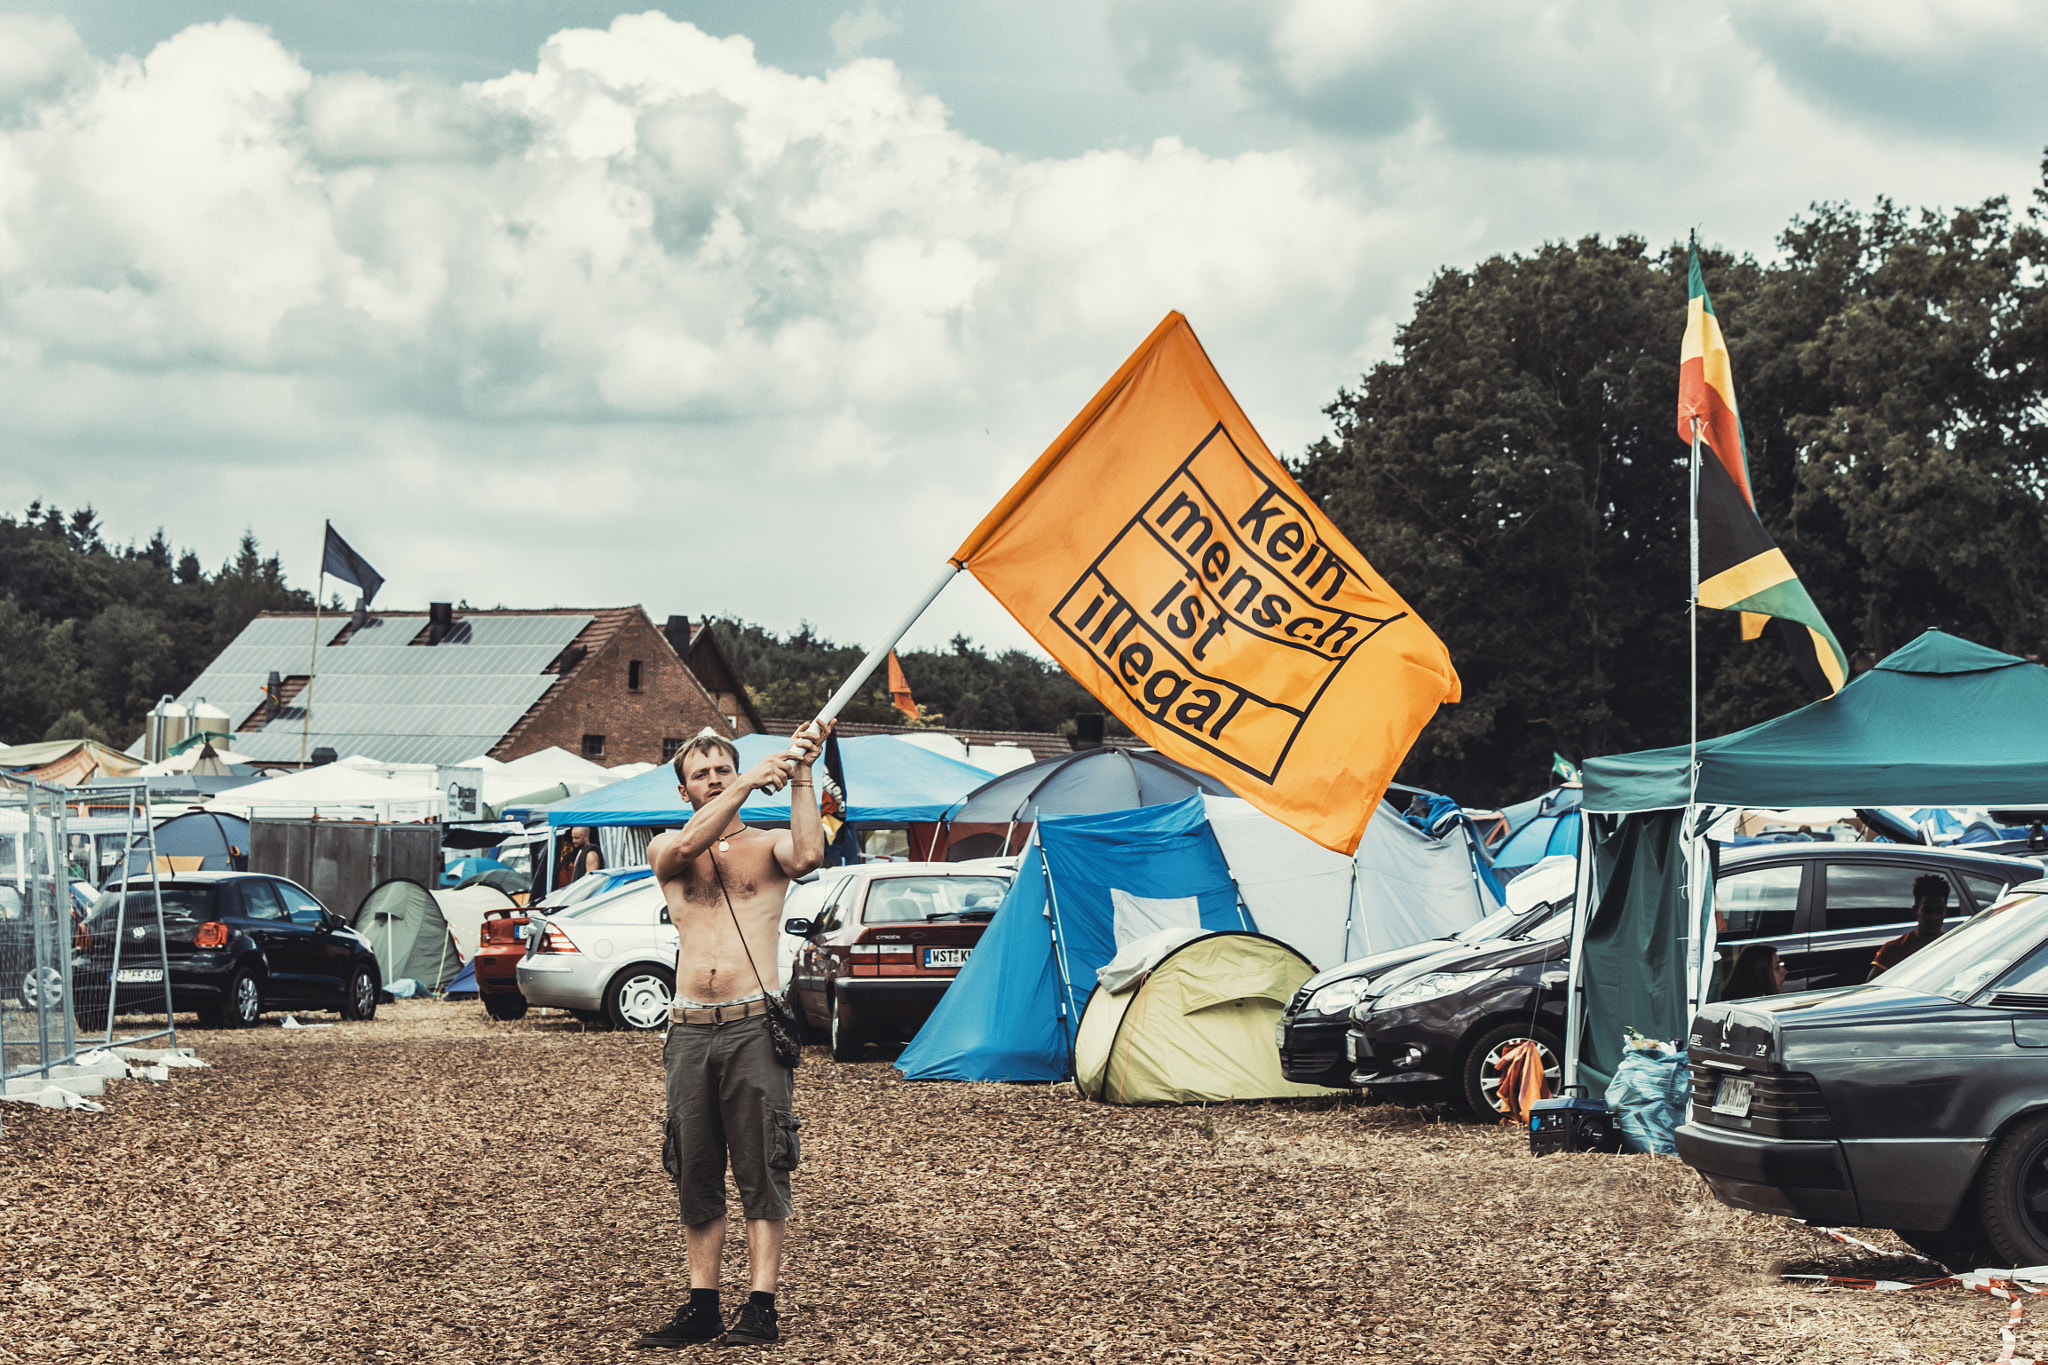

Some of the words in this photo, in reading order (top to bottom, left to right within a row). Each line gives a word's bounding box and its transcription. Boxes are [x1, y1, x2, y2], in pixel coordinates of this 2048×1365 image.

[1155, 490, 1359, 654] mensch
[1237, 485, 1348, 602] kein
[1074, 587, 1251, 741] illegal
[1151, 569, 1227, 662] ist
[932, 950, 954, 963] WST
